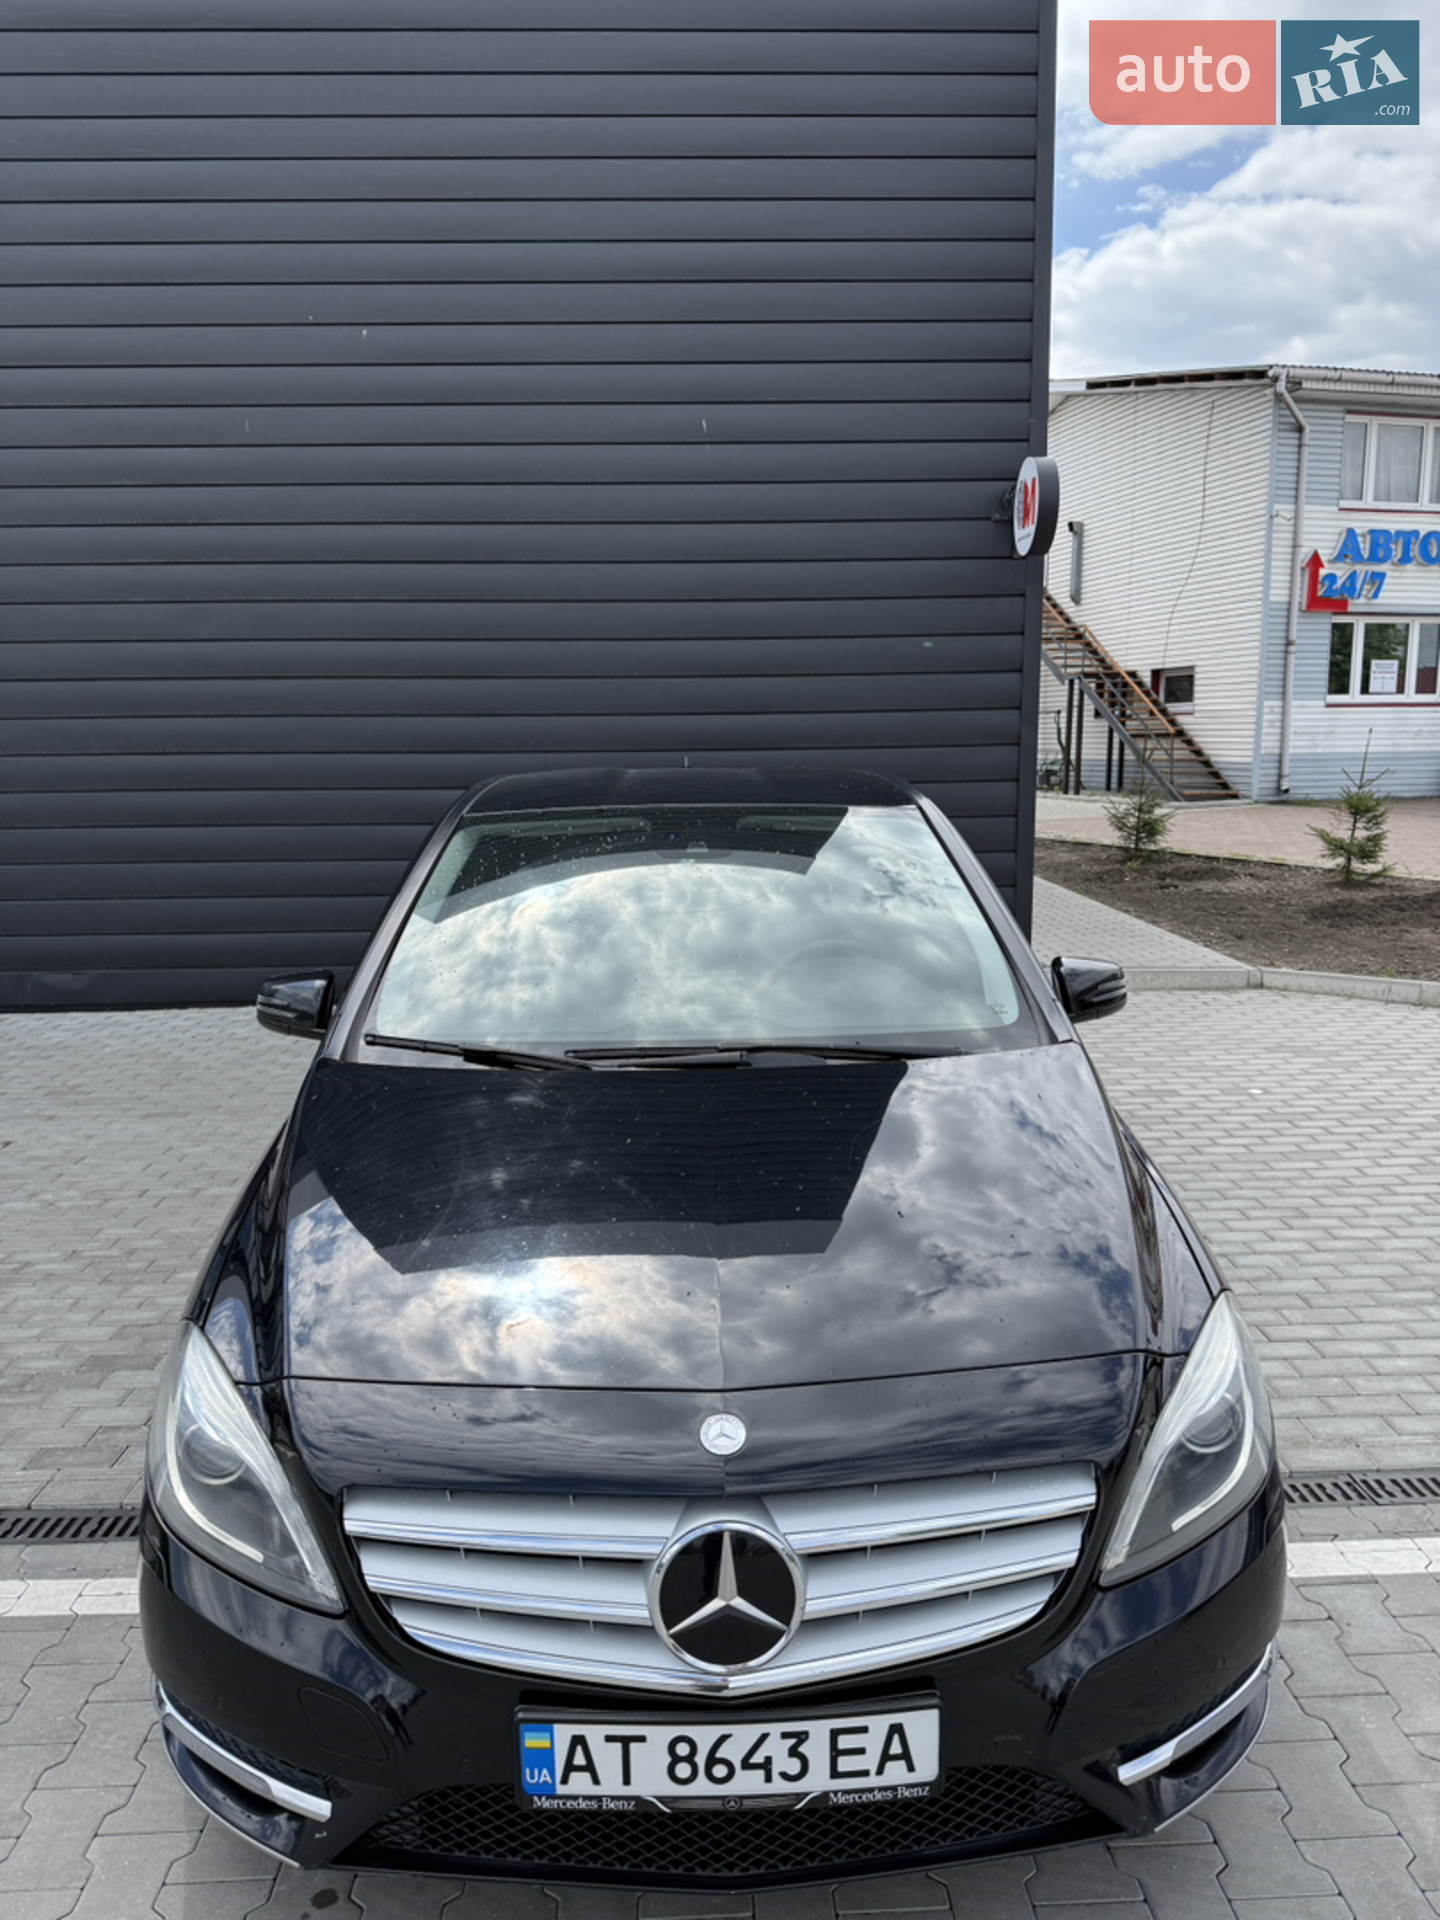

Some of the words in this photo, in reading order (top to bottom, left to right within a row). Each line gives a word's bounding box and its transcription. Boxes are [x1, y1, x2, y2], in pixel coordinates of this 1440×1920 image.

[1319, 569, 1387, 600] 24/7
[559, 1734, 647, 1786] AT
[666, 1731, 810, 1786] 8643
[829, 1722, 916, 1780] EA
[526, 1768, 553, 1785] UA
[532, 1796, 636, 1811] Mercedes-Benz
[829, 1785, 930, 1805] Mercedes-Benz
